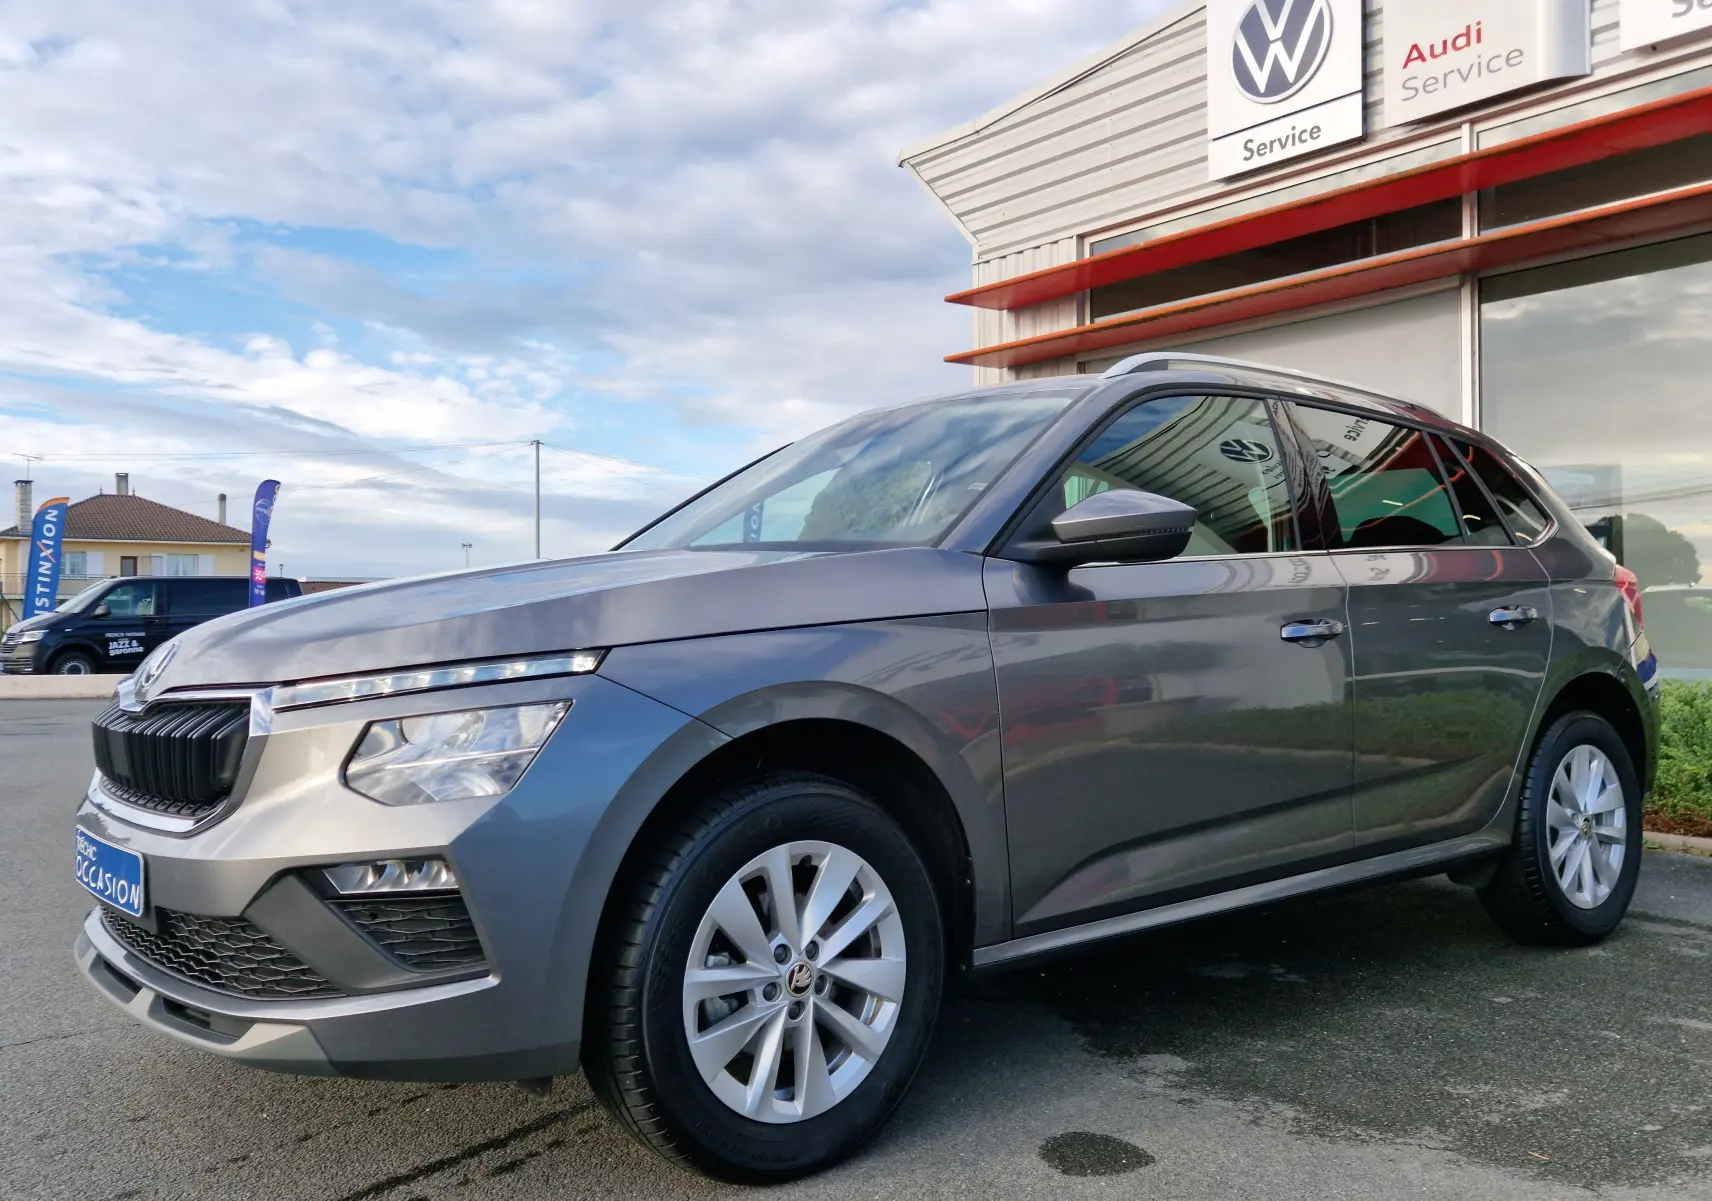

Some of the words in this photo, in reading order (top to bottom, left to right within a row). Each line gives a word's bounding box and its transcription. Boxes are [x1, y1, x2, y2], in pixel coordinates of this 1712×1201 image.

[1402, 20, 1482, 70] Audi
[1401, 48, 1524, 102] Service
[1242, 125, 1322, 162] Service
[108, 640, 130, 650] JAZZ
[131, 639, 139, 647] &
[109, 646, 144, 656] garonne
[75, 855, 141, 910] OCCASION
